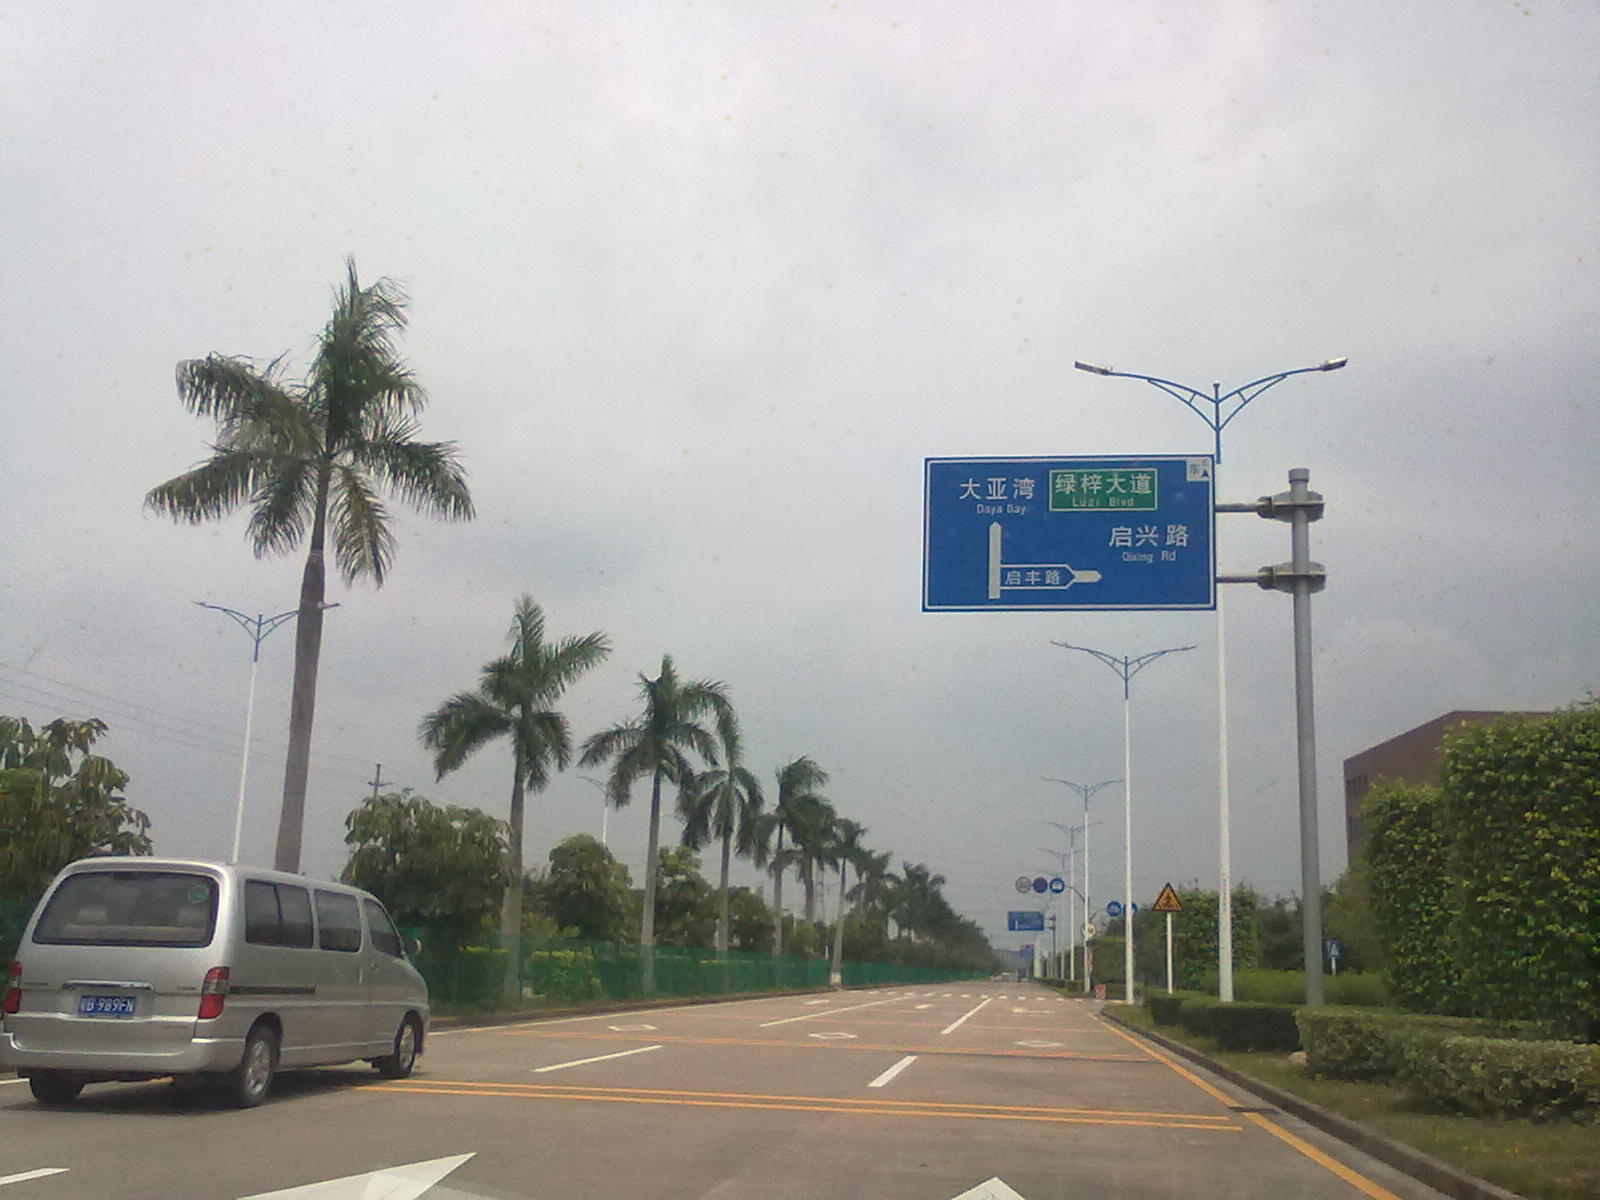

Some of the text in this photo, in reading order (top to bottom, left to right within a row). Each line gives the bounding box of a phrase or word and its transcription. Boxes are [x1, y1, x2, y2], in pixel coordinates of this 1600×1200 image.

[959, 476, 1036, 501] 大亚湾
[1055, 473, 1153, 496] 绿梓大道
[976, 503, 1027, 516] Daya Bay
[1072, 496, 1135, 508] Luzi Blvd
[1108, 525, 1189, 549] 启兴路
[1122, 550, 1177, 564] Qixing Rd
[1005, 569, 1061, 585] 启丰路
